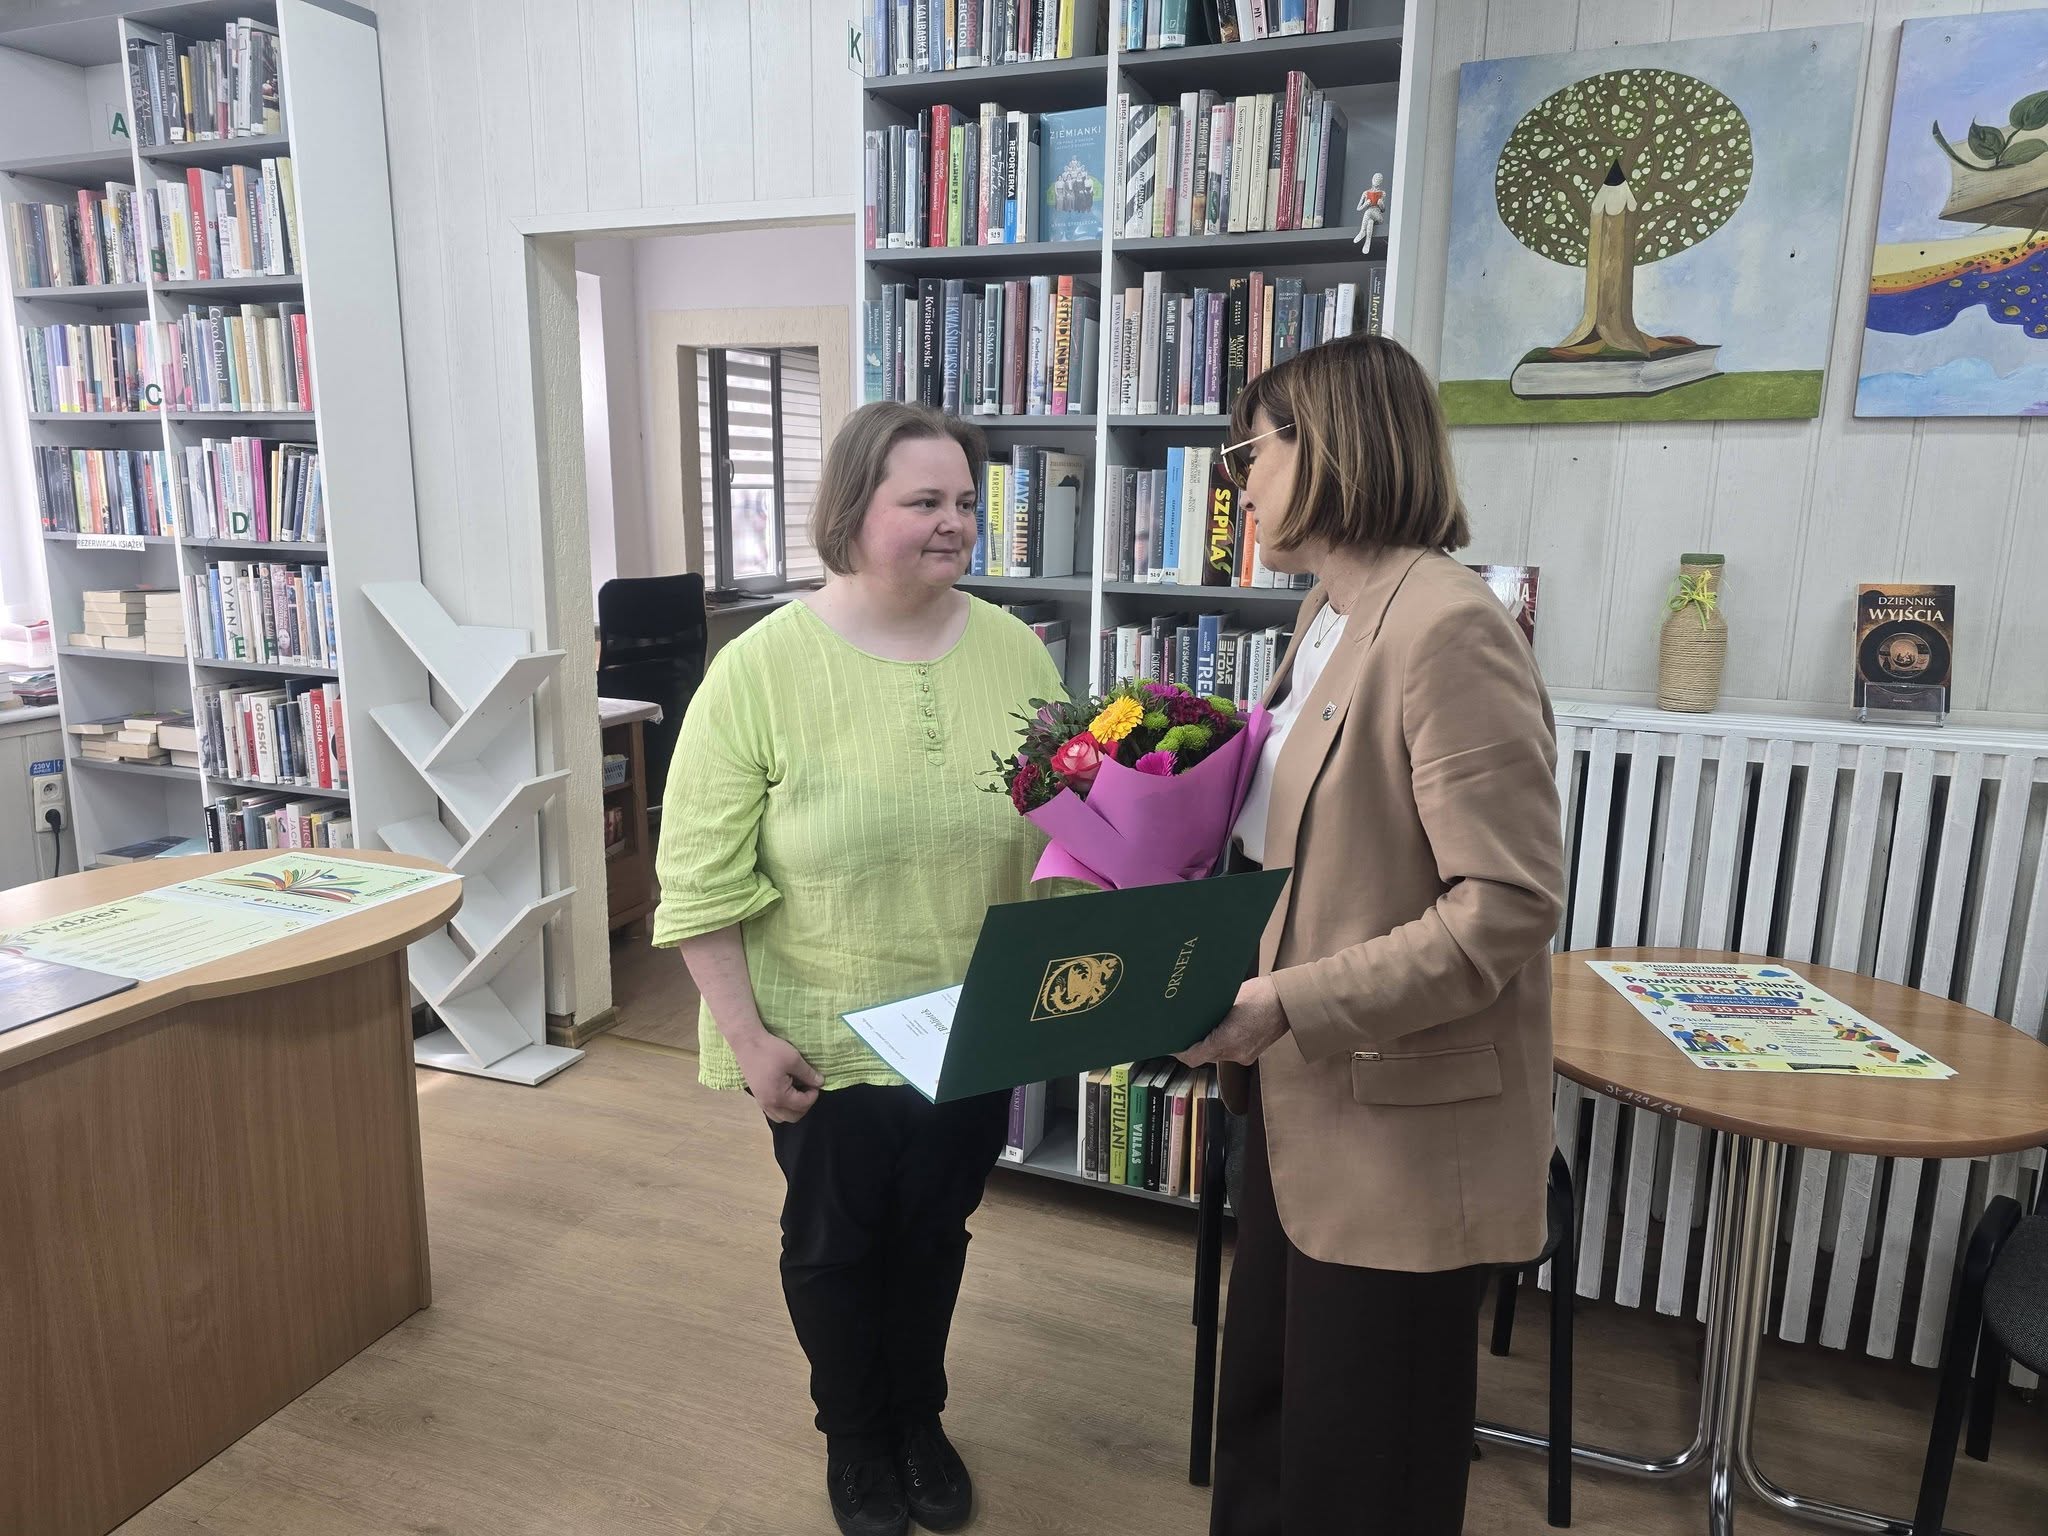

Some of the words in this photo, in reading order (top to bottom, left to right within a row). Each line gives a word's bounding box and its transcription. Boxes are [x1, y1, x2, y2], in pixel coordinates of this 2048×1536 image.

[851, 27, 863, 64] K
[917, 5, 928, 53] KALIBABKA
[166, 39, 174, 64] WOODY
[130, 64, 142, 110] ABBA
[142, 90, 150, 120] AZYL
[111, 112, 130, 139] A
[1050, 125, 1101, 140] ZIEMIANKI
[1199, 118, 1208, 154] POŁOWANIE
[1272, 109, 1283, 161] zhańbiona
[1184, 120, 1192, 165] wariatka
[1007, 140, 1016, 198] REPORTERKA
[1140, 172, 1145, 182] MY
[1198, 157, 1206, 167] NA
[1181, 166, 1190, 199] tańczy
[1195, 170, 1205, 197] ROMMLA
[193, 212, 203, 256] BEKSIŃSCY
[210, 308, 221, 339] Coco
[1059, 295, 1069, 335] ASTRID
[1167, 300, 1176, 324] WOJNA
[1371, 294, 1380, 320] Meryl
[923, 296, 934, 368] Kwaśniewska
[944, 307, 961, 378] KWAŚNIEWSKI
[986, 320, 996, 365] LEŚMIAN
[1123, 319, 1133, 371] Narzeczona
[1166, 326, 1174, 343] IRENY
[212, 339, 227, 382] Chanel
[886, 362, 891, 371] NA
[1056, 338, 1067, 388] LINDGREN
[1229, 338, 1237, 367] SMITH
[145, 384, 162, 405] C
[232, 512, 249, 534] D
[991, 502, 999, 532] MATCZAK
[1012, 469, 1030, 563] MAYBELLINE
[1210, 488, 1232, 562] SZPILA
[223, 576, 238, 640] DYMNA
[1869, 606, 1944, 622] WYJŚCIA
[1878, 597, 1936, 606] DZIENNIK
[235, 637, 246, 658] E
[1217, 640, 1225, 684] MOJE
[1151, 651, 1160, 681] TOLKIE
[1197, 653, 1214, 698] TREL
[255, 703, 267, 755] GÓRSKI
[313, 703, 323, 743] GRZESIUK
[32, 762, 51, 772] 230V
[26, 906, 128, 936] Tydzień
[1164, 936, 1198, 999] ORNETA
[1622, 975, 1806, 991] Powiatowo-Gminne
[1650, 983, 1695, 994] Dni
[1702, 984, 1804, 1000] Rodziny
[1713, 1006, 1730, 1014] 30
[1734, 1006, 1771, 1016] maja
[1773, 1008, 1808, 1016] 2026
[1112, 1084, 1126, 1150] VETULANI
[1132, 1123, 1143, 1164] VILLAS
